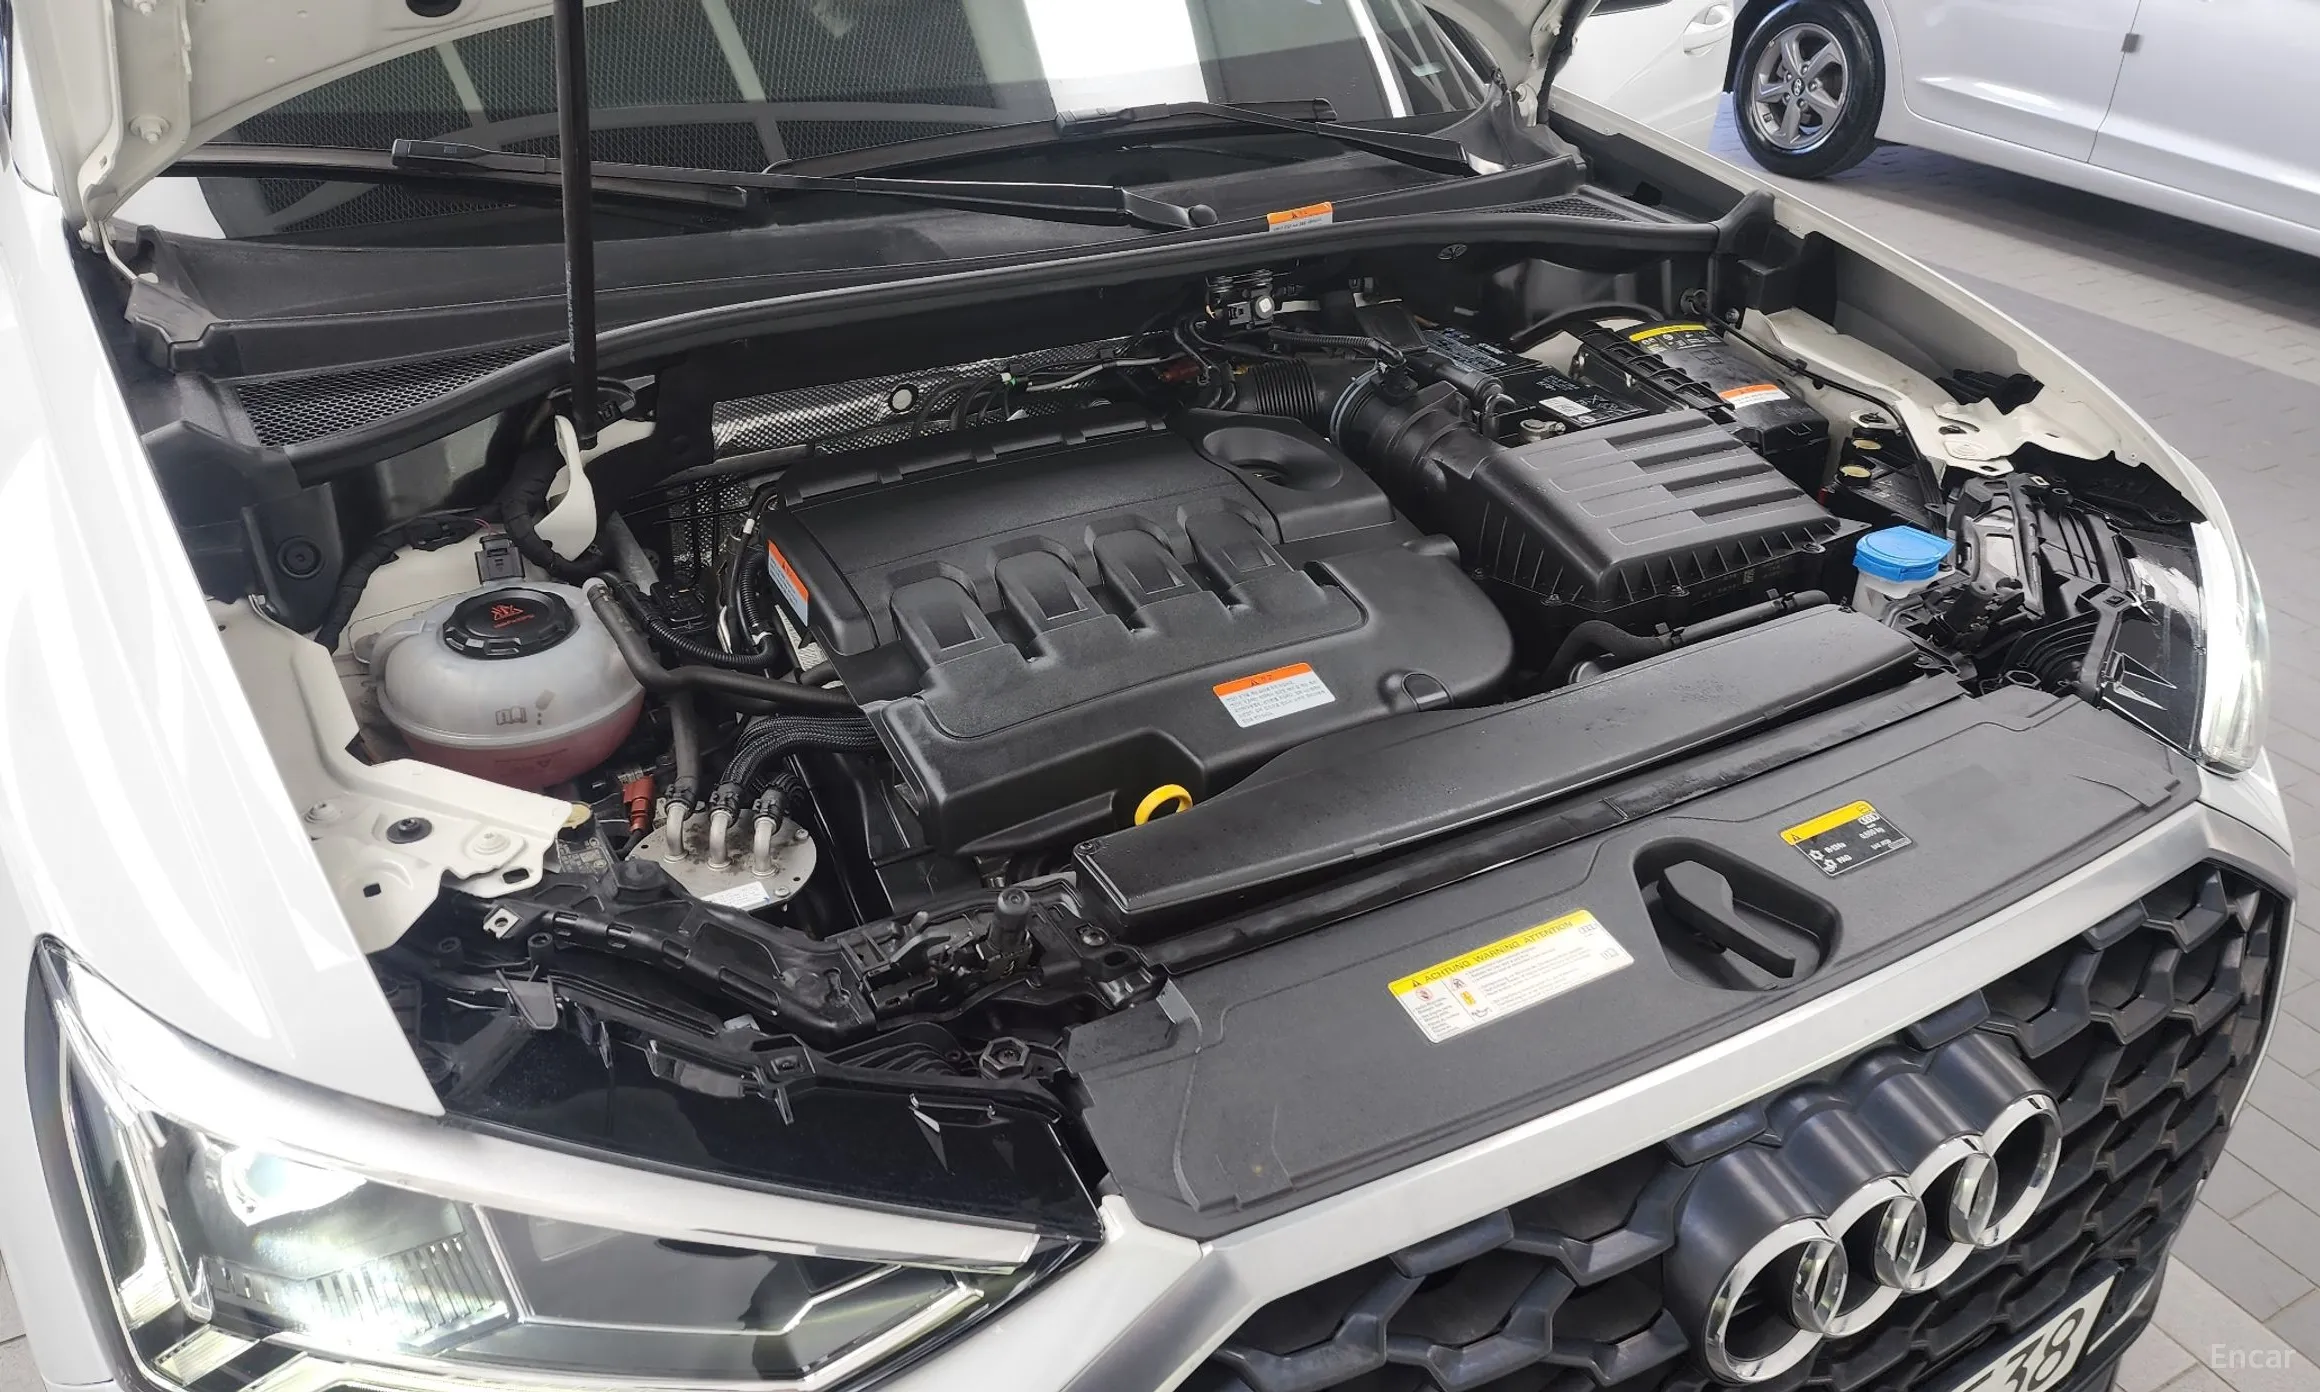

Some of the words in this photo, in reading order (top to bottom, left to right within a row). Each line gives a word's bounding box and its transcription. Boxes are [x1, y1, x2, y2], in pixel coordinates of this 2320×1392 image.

[1424, 960, 1471, 982] ACHTUNG
[1475, 941, 1520, 963] WARNING
[1524, 920, 1573, 944] ATTENTION
